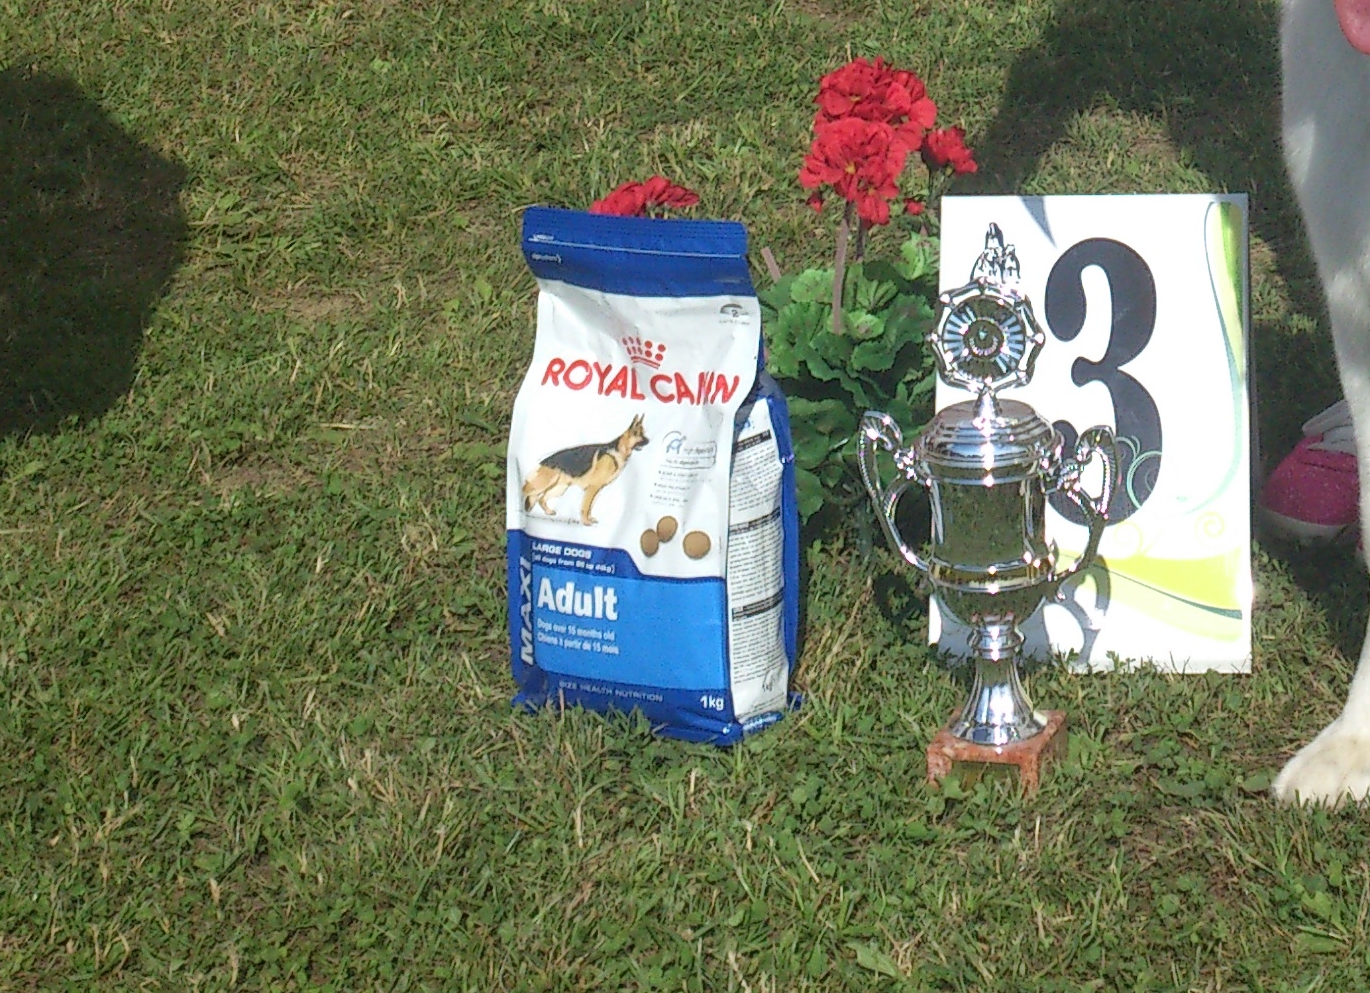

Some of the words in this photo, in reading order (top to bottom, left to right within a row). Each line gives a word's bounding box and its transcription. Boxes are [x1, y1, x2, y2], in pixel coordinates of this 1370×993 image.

[541, 358, 646, 401] ROYAL
[650, 371, 740, 406] CANIN
[1045, 237, 1162, 527] 3
[532, 542, 561, 555] LARGE
[564, 548, 592, 559] DOGS
[520, 557, 533, 666] MAXI
[538, 577, 618, 620] Adult
[580, 683, 613, 695] HEALTH
[615, 689, 664, 703] NUTRITION
[700, 694, 724, 711] 1kg
